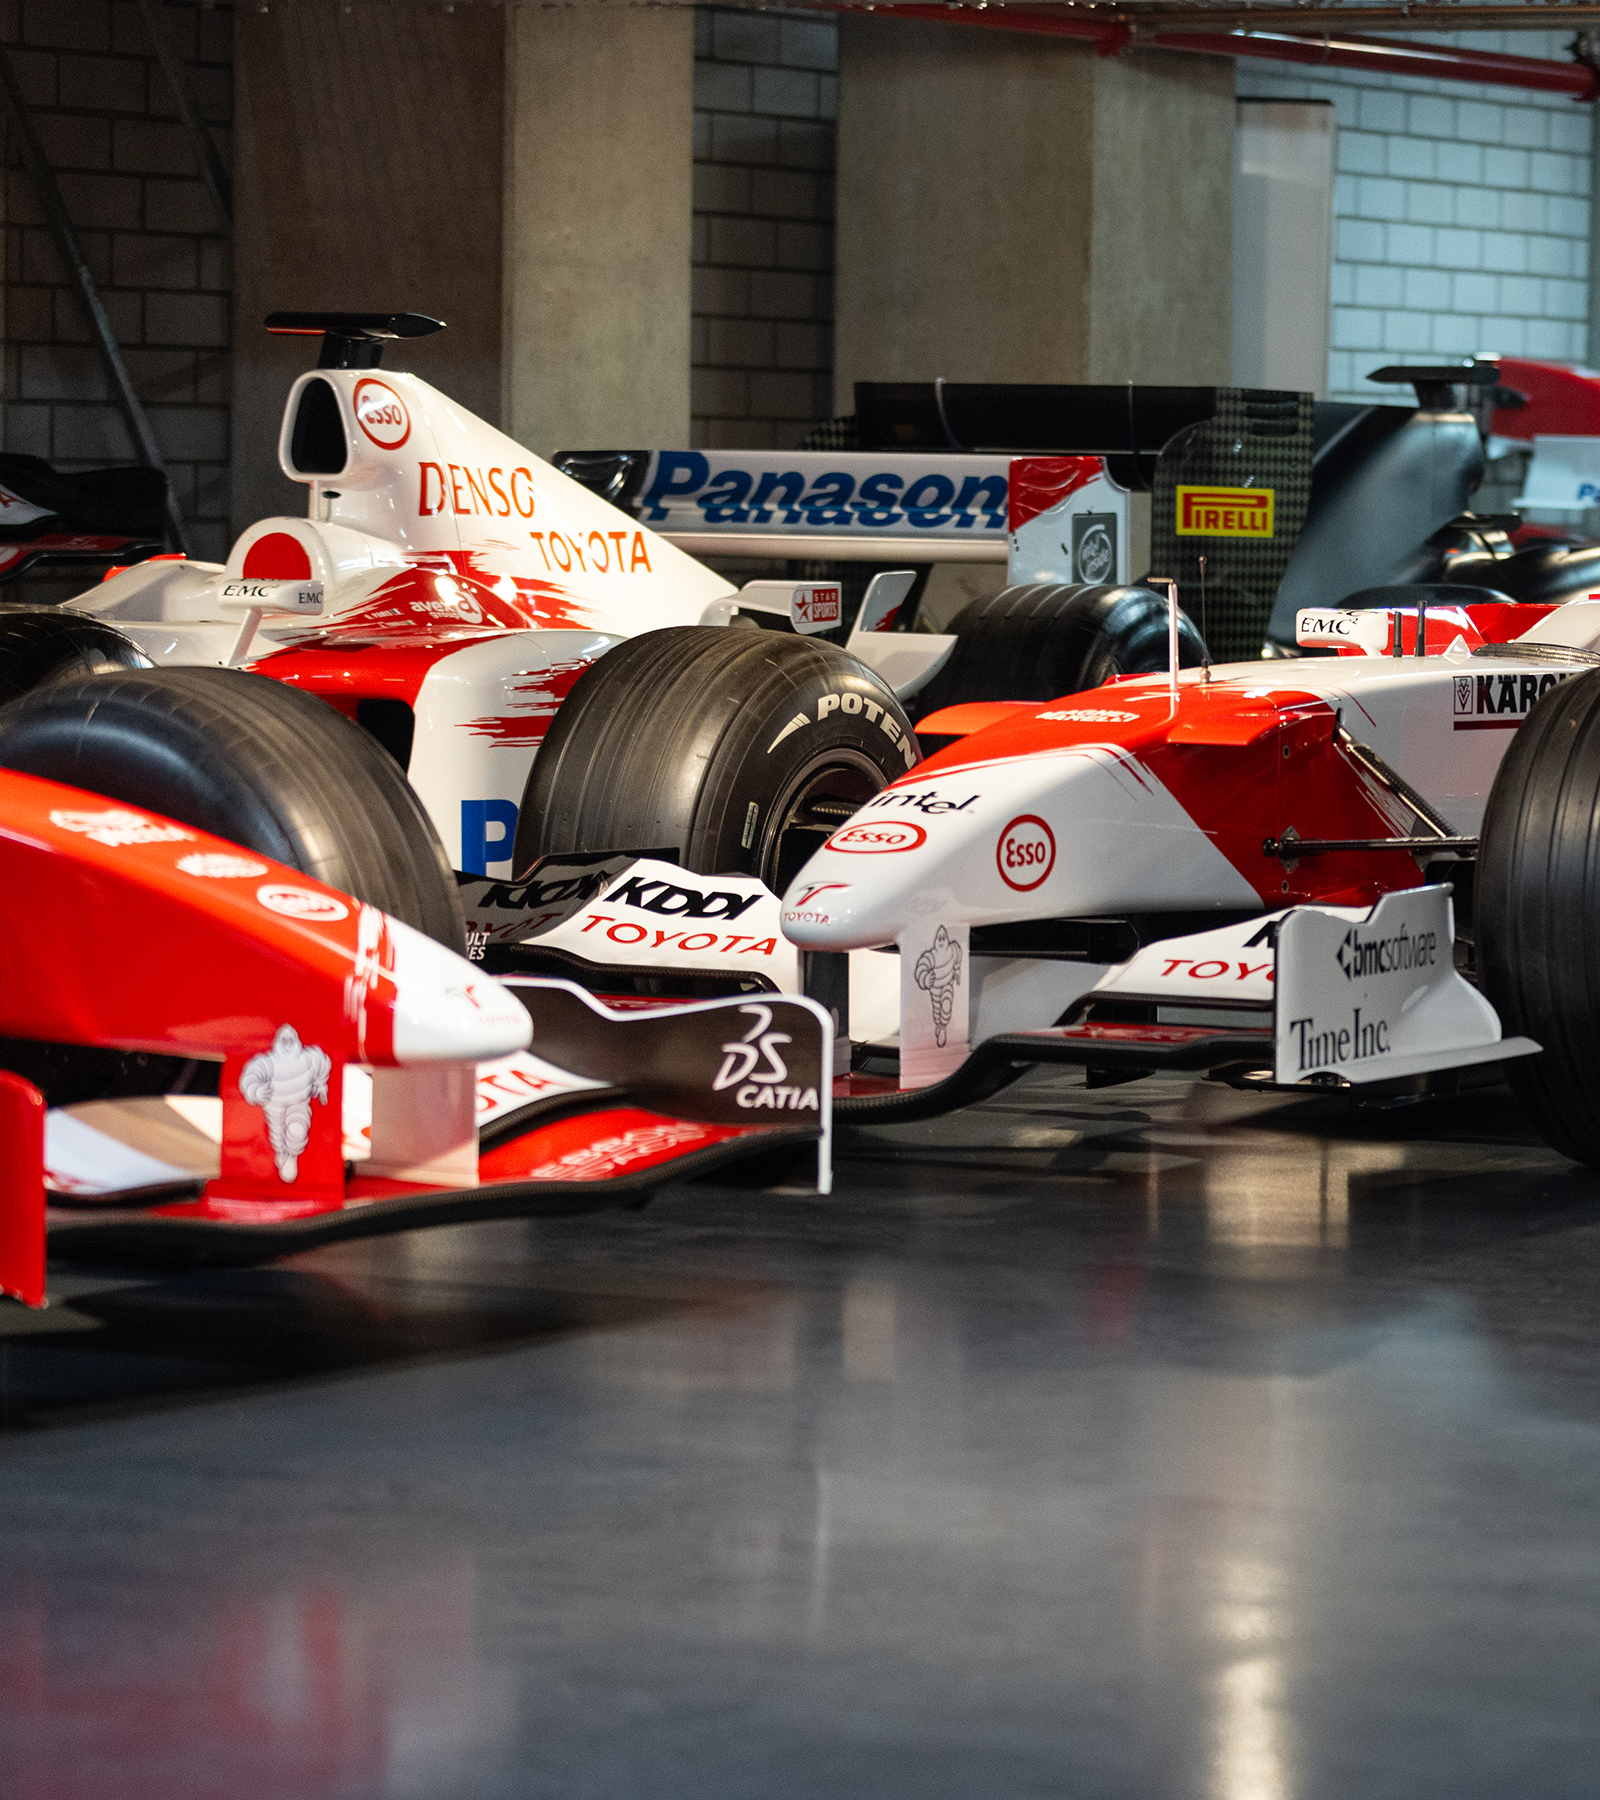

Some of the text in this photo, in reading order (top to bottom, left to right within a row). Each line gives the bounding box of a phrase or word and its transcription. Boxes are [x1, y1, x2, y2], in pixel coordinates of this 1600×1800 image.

[418, 461, 535, 519] DENSO
[1182, 490, 1269, 532] PIRELLI
[530, 531, 653, 573] TOYOTA
[813, 602, 837, 619] SPORTS
[814, 593, 837, 602] STAR
[869, 791, 981, 815] intel
[839, 829, 907, 845] Esso
[1006, 838, 1046, 869] Esso
[604, 876, 764, 921] KDDI
[784, 912, 830, 925] TOYOTA
[580, 914, 778, 955] TOYOTA
[1160, 959, 1275, 982] TOY
[1290, 1007, 1391, 1071] Time Inc.
[736, 1086, 818, 1111] CATIA
